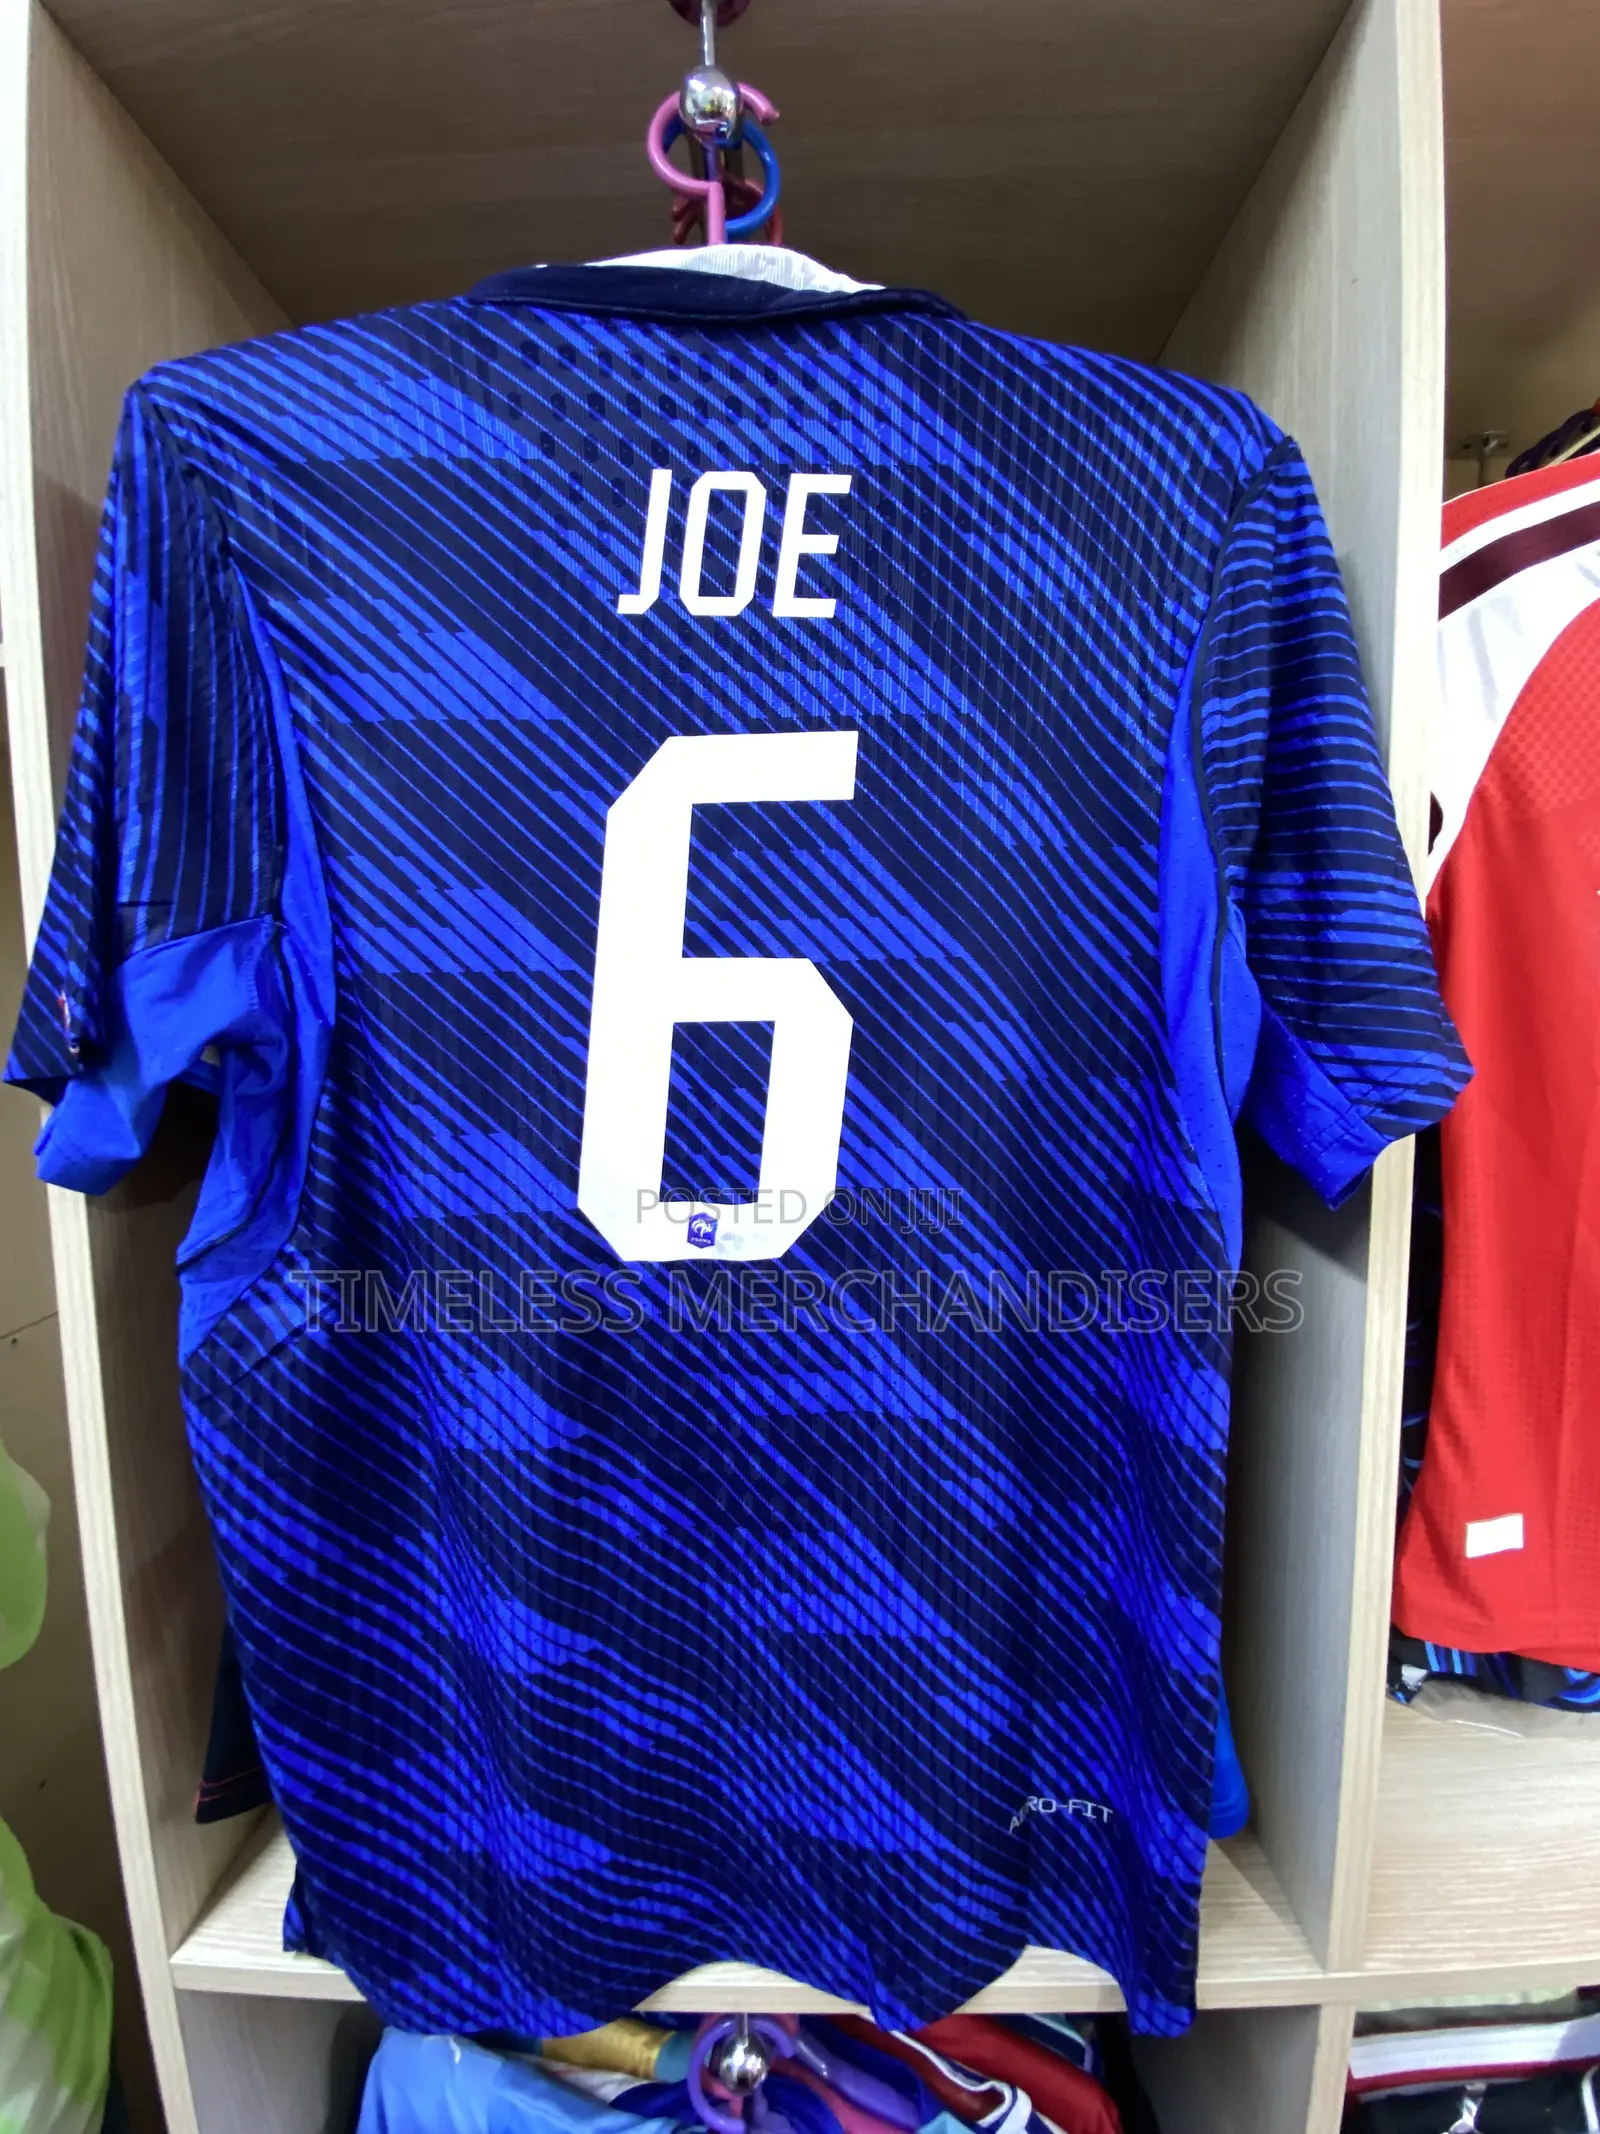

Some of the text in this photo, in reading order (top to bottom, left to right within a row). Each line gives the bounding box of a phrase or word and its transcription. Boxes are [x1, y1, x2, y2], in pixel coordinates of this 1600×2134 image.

[617, 468, 852, 618] JOE
[577, 731, 858, 1261] 6
[1008, 1796, 1114, 1834] ARO-FIT
